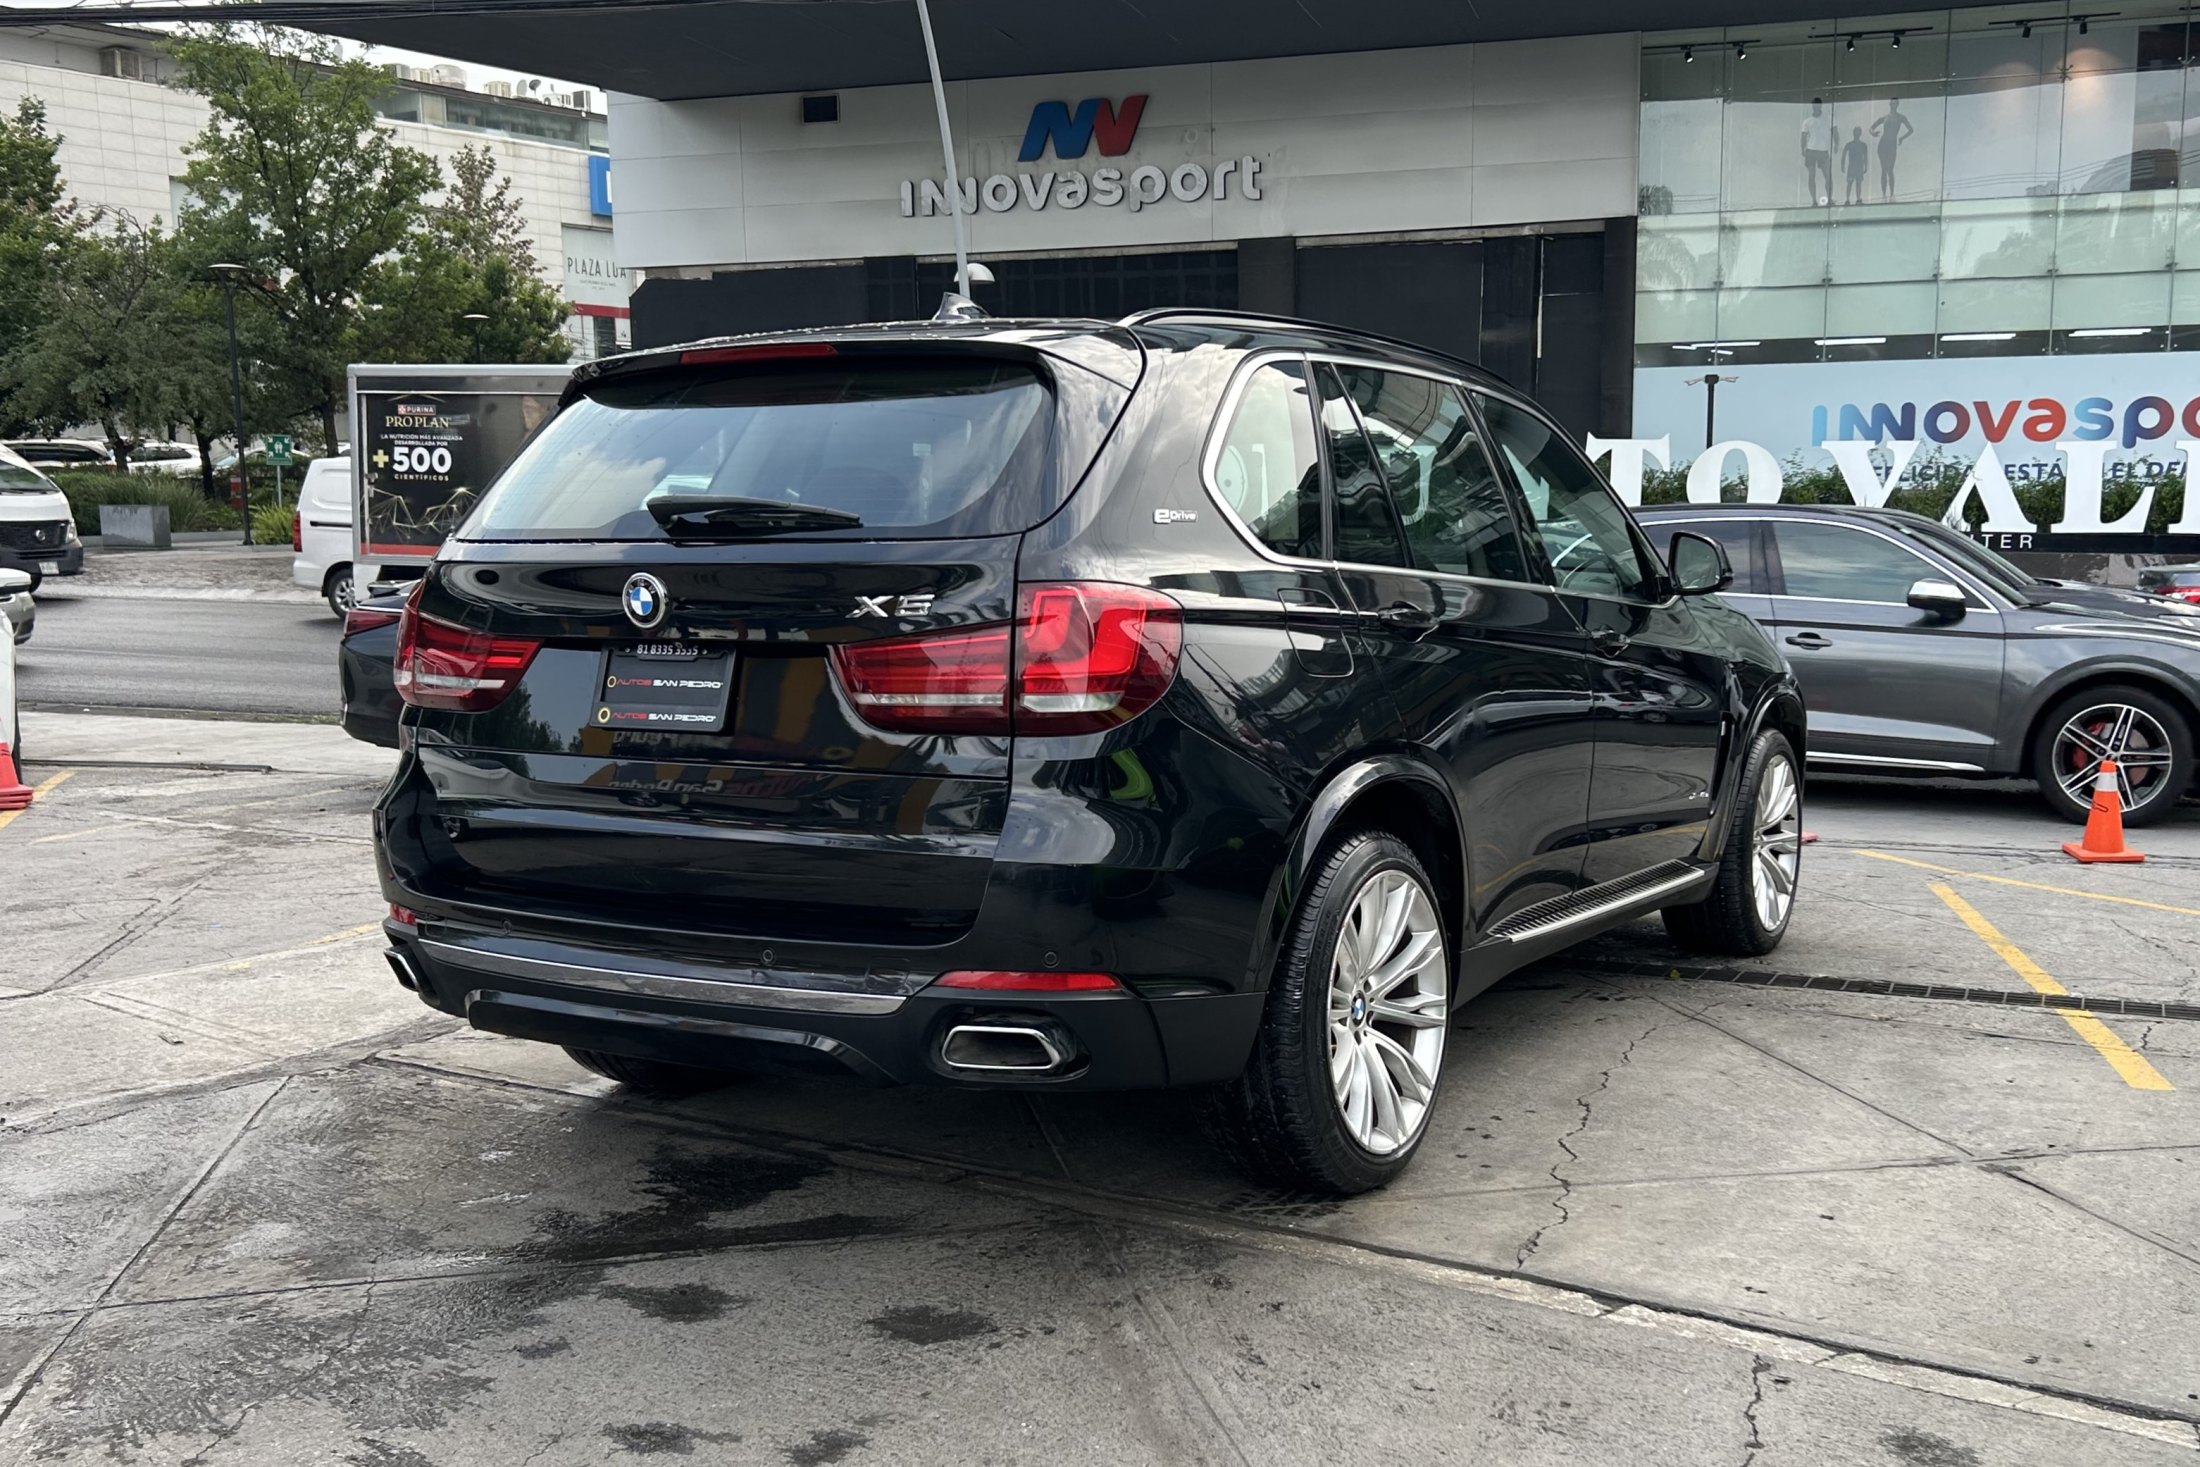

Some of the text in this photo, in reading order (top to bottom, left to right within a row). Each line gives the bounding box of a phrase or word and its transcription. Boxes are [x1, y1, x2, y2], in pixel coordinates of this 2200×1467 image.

[567, 256, 602, 277] PLAZA
[385, 415, 449, 428] PRO PLAN
[845, 593, 936, 618] X5
[637, 644, 648, 655] 81
[653, 679, 678, 687] SAN
[674, 714, 716, 722] PEDRO
